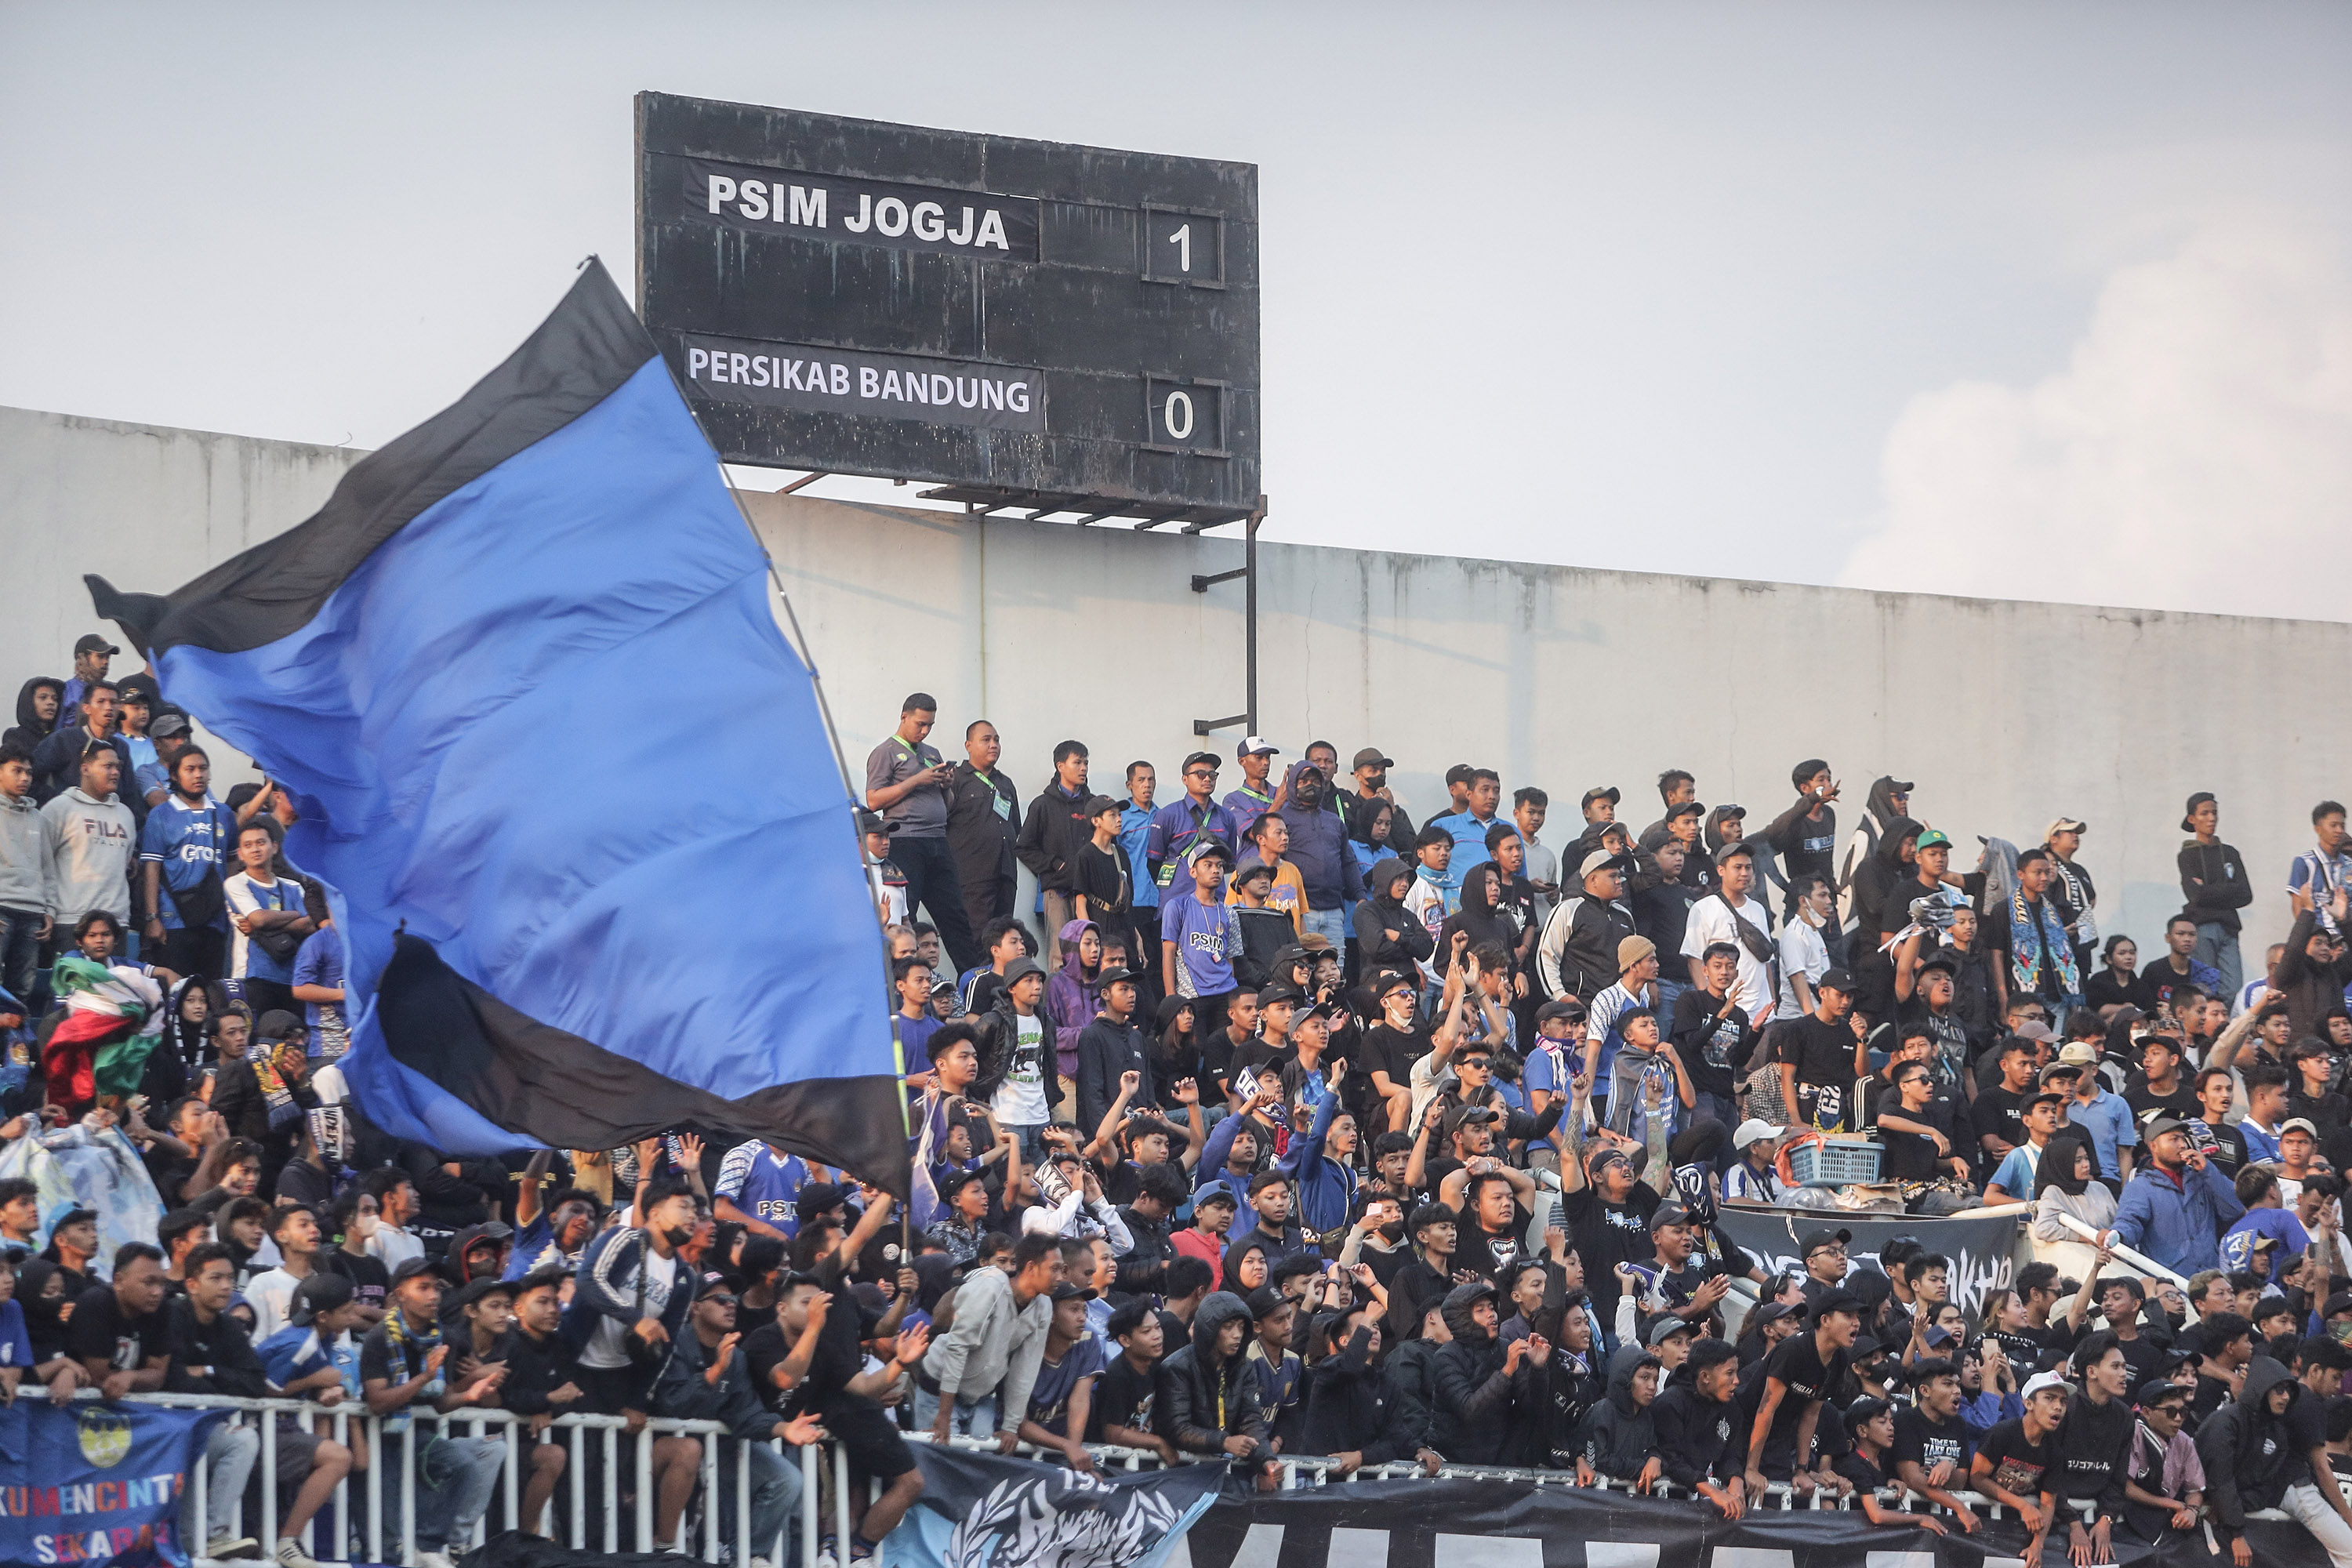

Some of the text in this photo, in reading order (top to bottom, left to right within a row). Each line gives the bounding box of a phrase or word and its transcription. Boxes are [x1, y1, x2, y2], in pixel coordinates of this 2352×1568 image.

[708, 174, 1010, 251] PSIM JOGJA
[1169, 223, 1191, 272] 1
[688, 348, 1030, 413] PERSIKAB BANDUNG
[1163, 390, 1194, 440] 0
[84, 818, 128, 840] FILA
[1923, 1443, 1962, 1457] TAKE OVE
